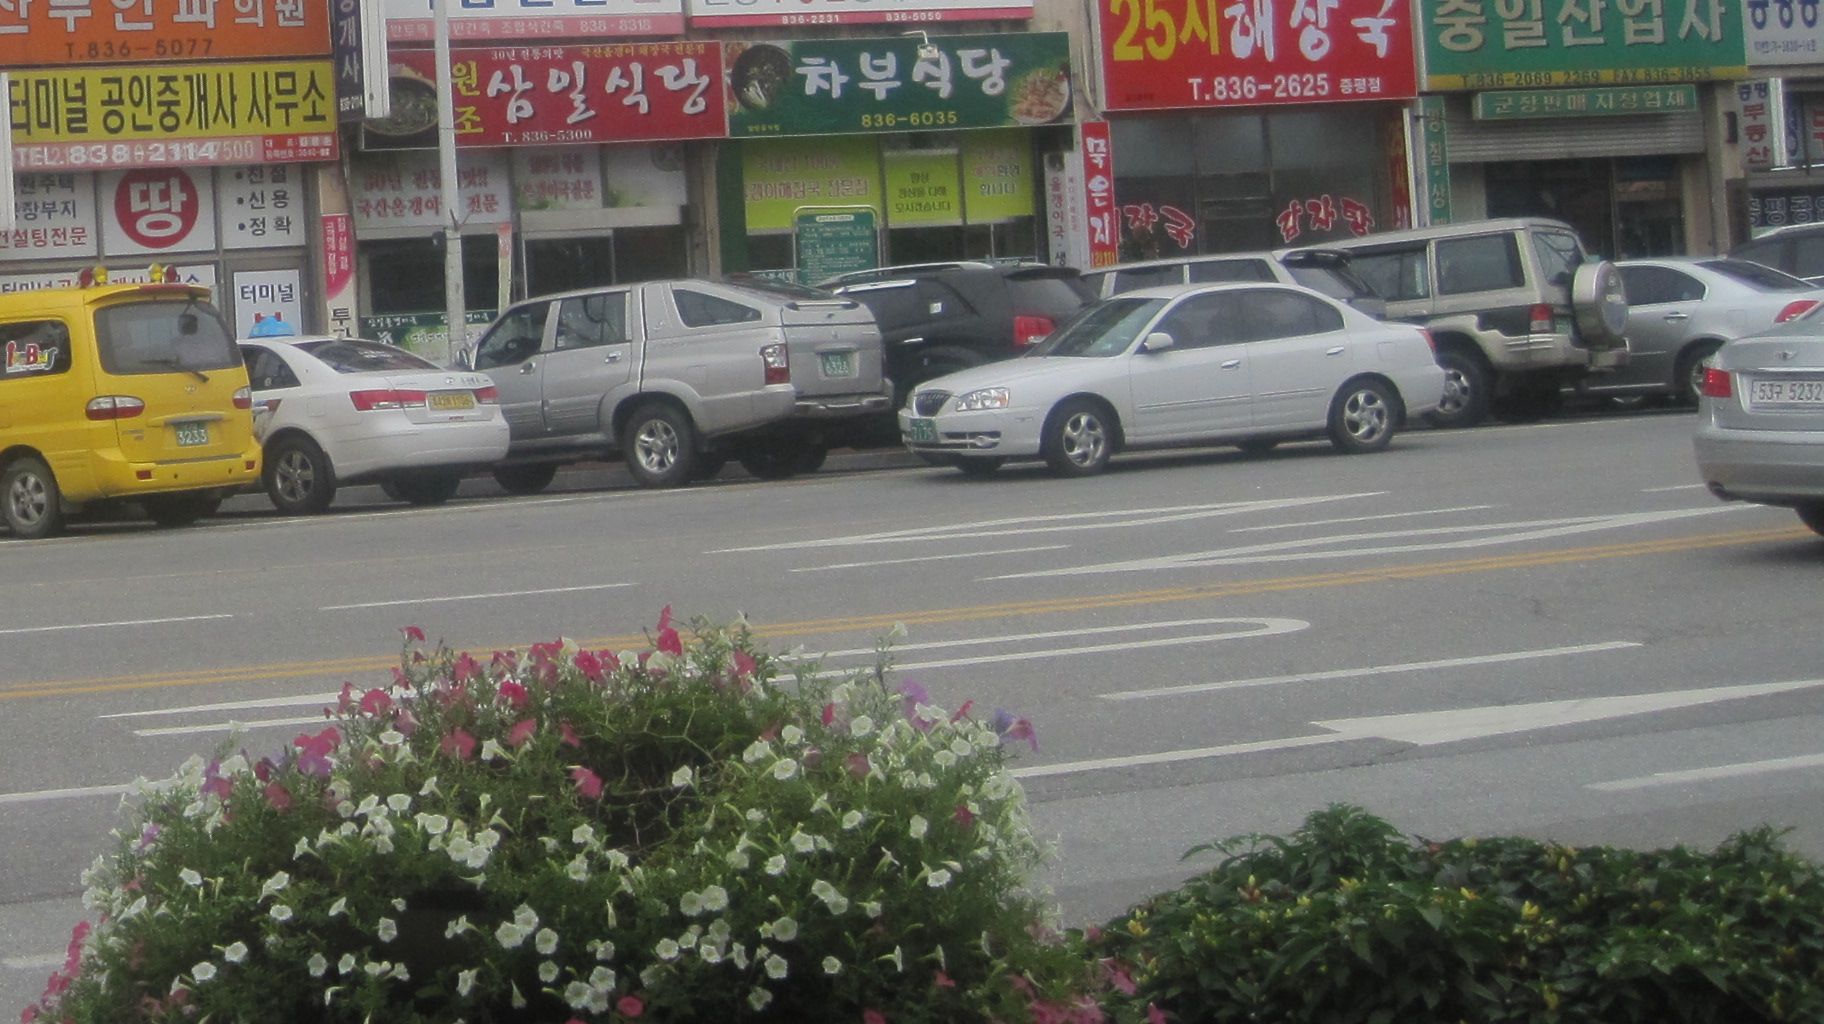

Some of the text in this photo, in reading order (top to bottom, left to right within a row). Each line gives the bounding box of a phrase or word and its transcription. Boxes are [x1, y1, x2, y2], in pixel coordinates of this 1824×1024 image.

[486, 58, 711, 125] 삼일식당
[795, 47, 1012, 101] 차부식당
[1188, 73, 1329, 101] T.836-2625
[99, 72, 237, 135] 공인중개사
[247, 69, 327, 128] 사무소
[861, 110, 959, 128] 836-6035
[128, 176, 188, 238] 땅
[240, 282, 296, 304] 터미널
